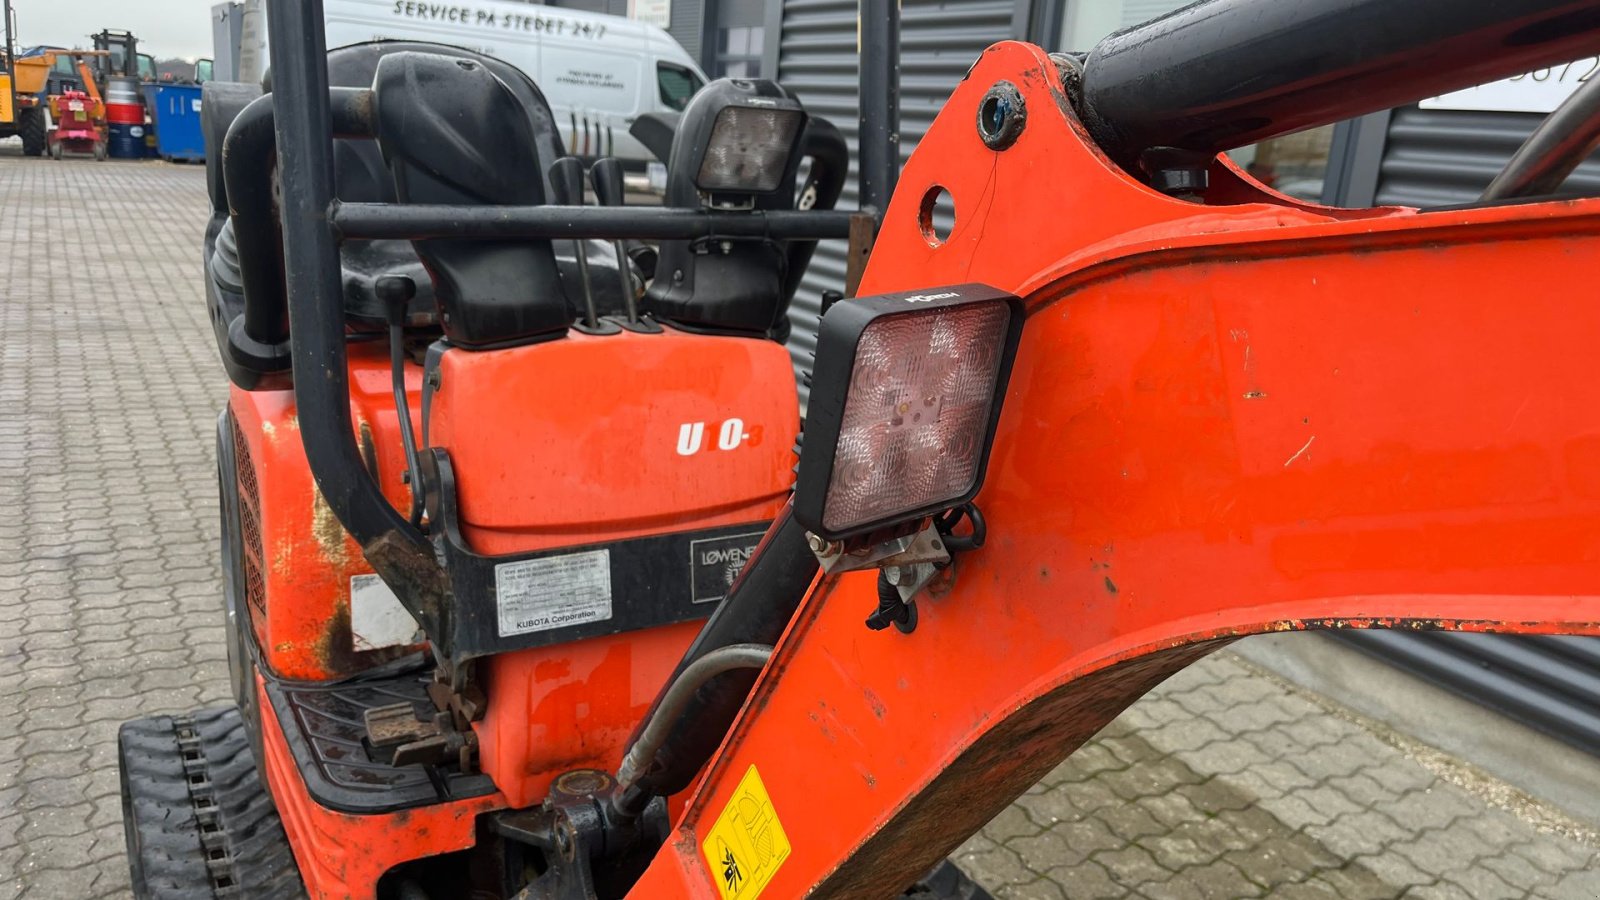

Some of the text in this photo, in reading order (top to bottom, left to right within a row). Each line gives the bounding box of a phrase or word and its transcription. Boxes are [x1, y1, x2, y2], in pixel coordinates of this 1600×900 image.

[393, 0, 470, 23] SERVICE
[502, 14, 565, 35] STEDET
[516, 610, 596, 629] KUBOTA Corporation
